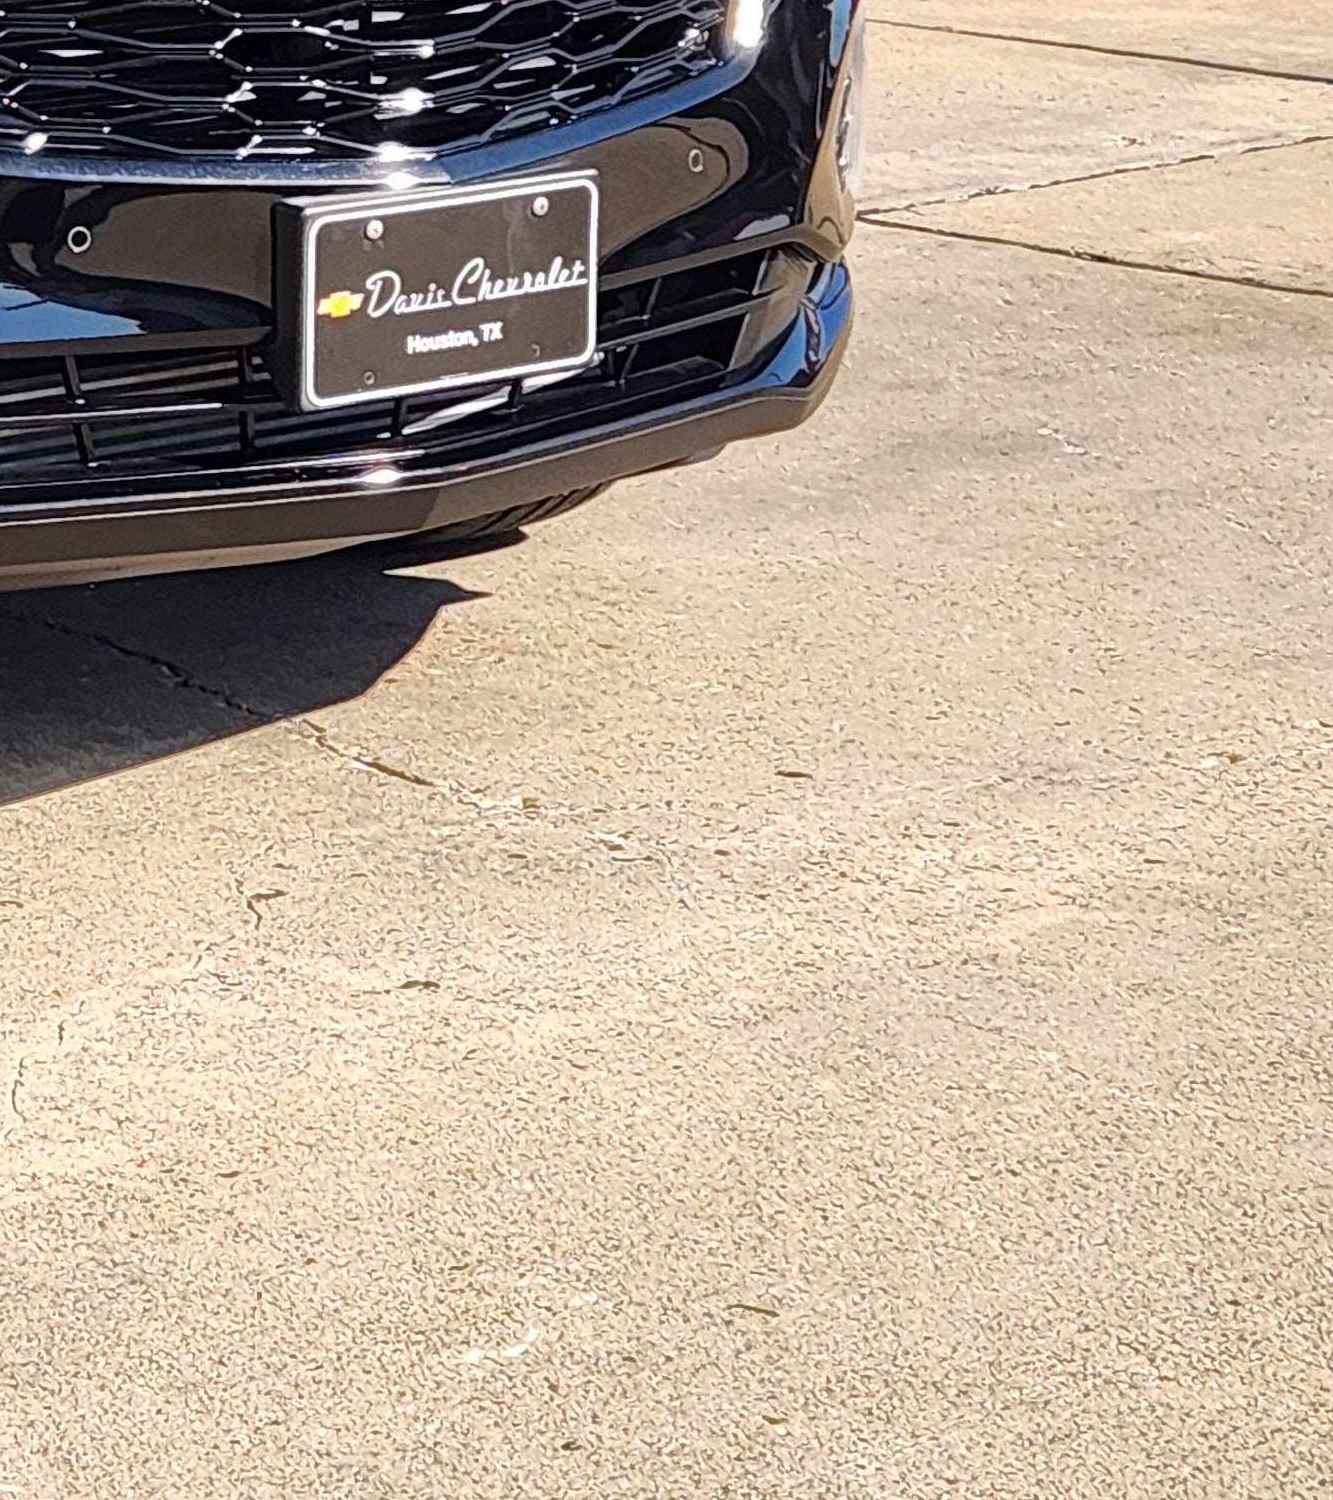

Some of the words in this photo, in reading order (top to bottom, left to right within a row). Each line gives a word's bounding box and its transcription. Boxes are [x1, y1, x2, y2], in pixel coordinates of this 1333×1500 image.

[366, 269, 452, 318] Davis
[452, 256, 588, 305] Chevrolet
[406, 329, 479, 355] Houston,
[479, 321, 504, 342] TX
